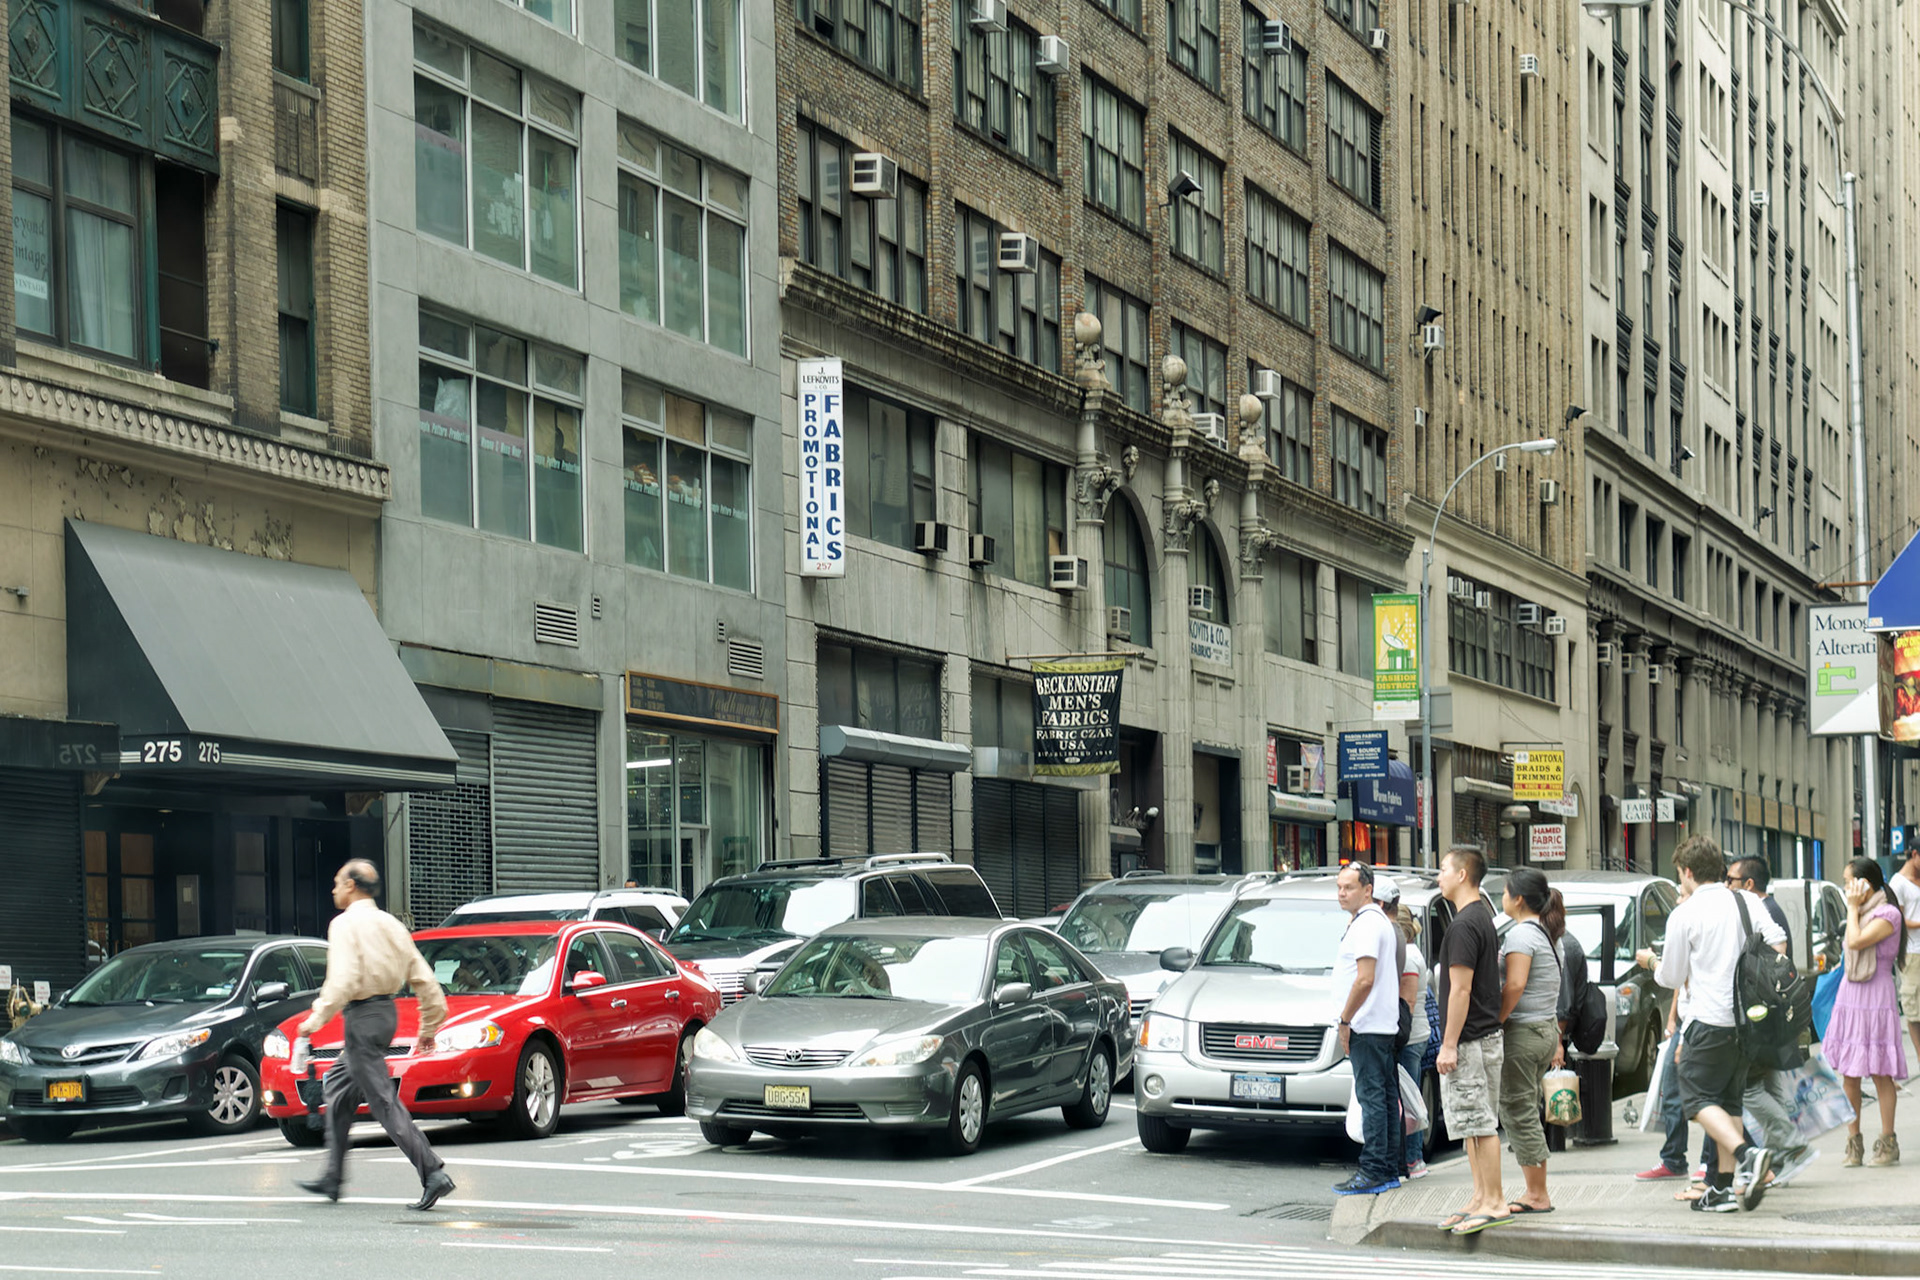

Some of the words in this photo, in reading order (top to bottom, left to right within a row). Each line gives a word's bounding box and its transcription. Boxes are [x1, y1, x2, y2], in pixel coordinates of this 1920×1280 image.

[802, 375, 839, 384] LEFKOVITS
[803, 394, 820, 559] PROMOTIONAL
[824, 395, 842, 560] FABRICS
[1816, 638, 1876, 655] Alterati
[1035, 674, 1118, 695] BECKENSTEIN
[1376, 682, 1416, 690] DISTRICT
[1048, 694, 1101, 710] MEN'S
[1041, 709, 1109, 726] FABRICS
[1036, 729, 1077, 740] FABRIC
[1080, 727, 1113, 739] CZAR
[144, 741, 182, 763] 275
[199, 741, 220, 764] 275
[1059, 740, 1086, 750] USA
[1529, 754, 1562, 763] DAYTONA
[1516, 773, 1562, 781] TRIMMING
[1533, 826, 1561, 835] HAMED
[1532, 836, 1562, 844] FABRIC
[1892, 830, 1903, 850] P
[1235, 1035, 1289, 1050] GMC
